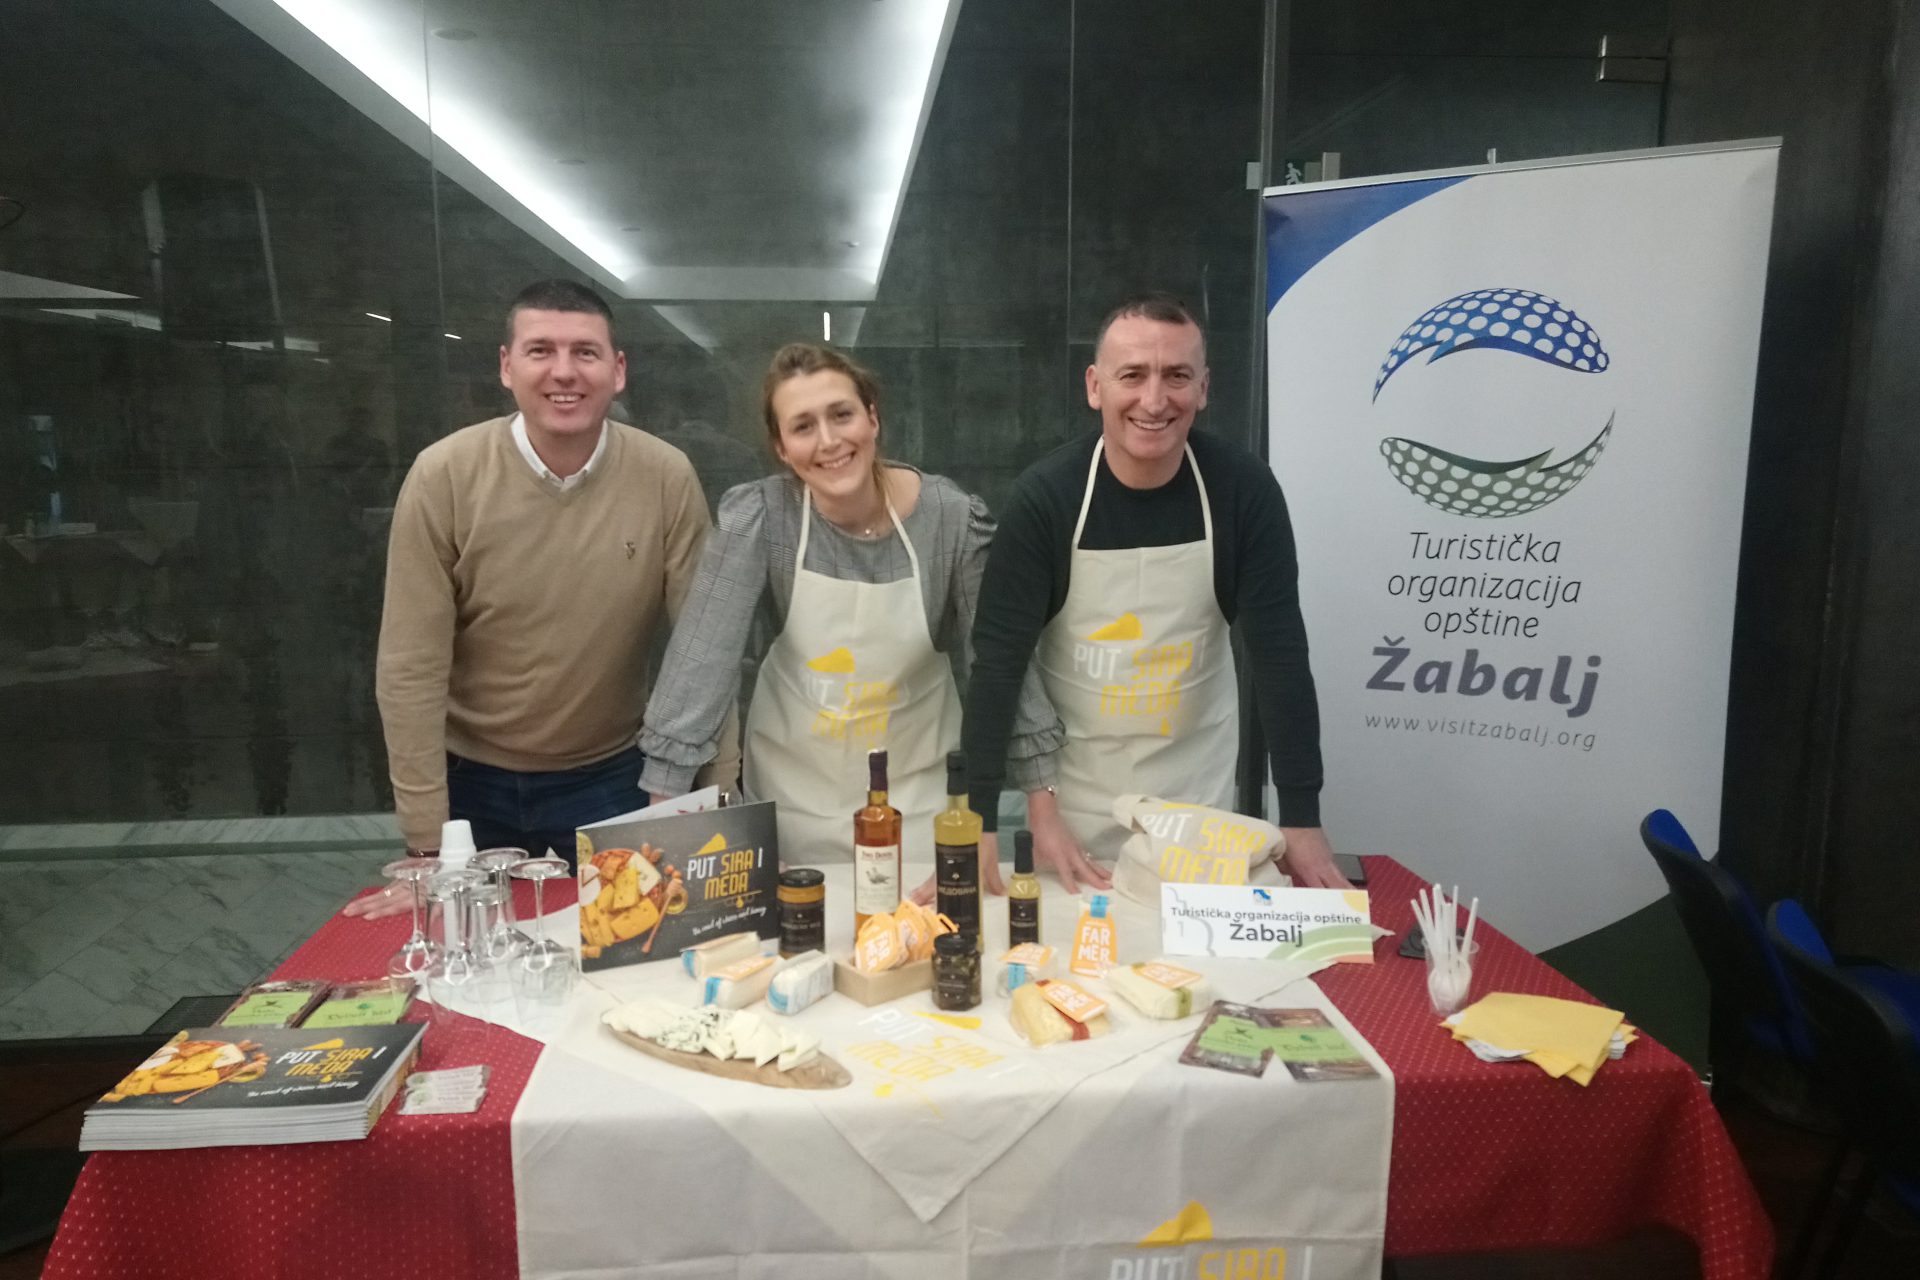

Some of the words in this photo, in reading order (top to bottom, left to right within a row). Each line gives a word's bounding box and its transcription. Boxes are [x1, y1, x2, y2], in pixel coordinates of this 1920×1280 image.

[1410, 531, 1562, 564] Turistička
[1387, 572, 1582, 609] organizacija
[1424, 606, 1540, 640] opštine
[1073, 643, 1122, 681] PUT
[1365, 635, 1602, 719] Žabalj
[1100, 679, 1181, 716] MEDA
[1365, 715, 1596, 752] www.visitzabalj.org
[687, 855, 717, 881] PUT
[721, 849, 754, 875] SIRA
[757, 846, 764, 869] I
[704, 871, 749, 900] MEDA
[1170, 906, 1232, 920] Turistička
[1234, 910, 1311, 925] organizacija
[1313, 912, 1362, 925] opštine
[1081, 926, 1111, 946] FAR
[1229, 918, 1303, 948] Žabalj
[1078, 944, 1111, 962] MER
[275, 1050, 325, 1065] PUT
[321, 1047, 374, 1063] SIRA
[285, 1060, 354, 1077] MEDA
